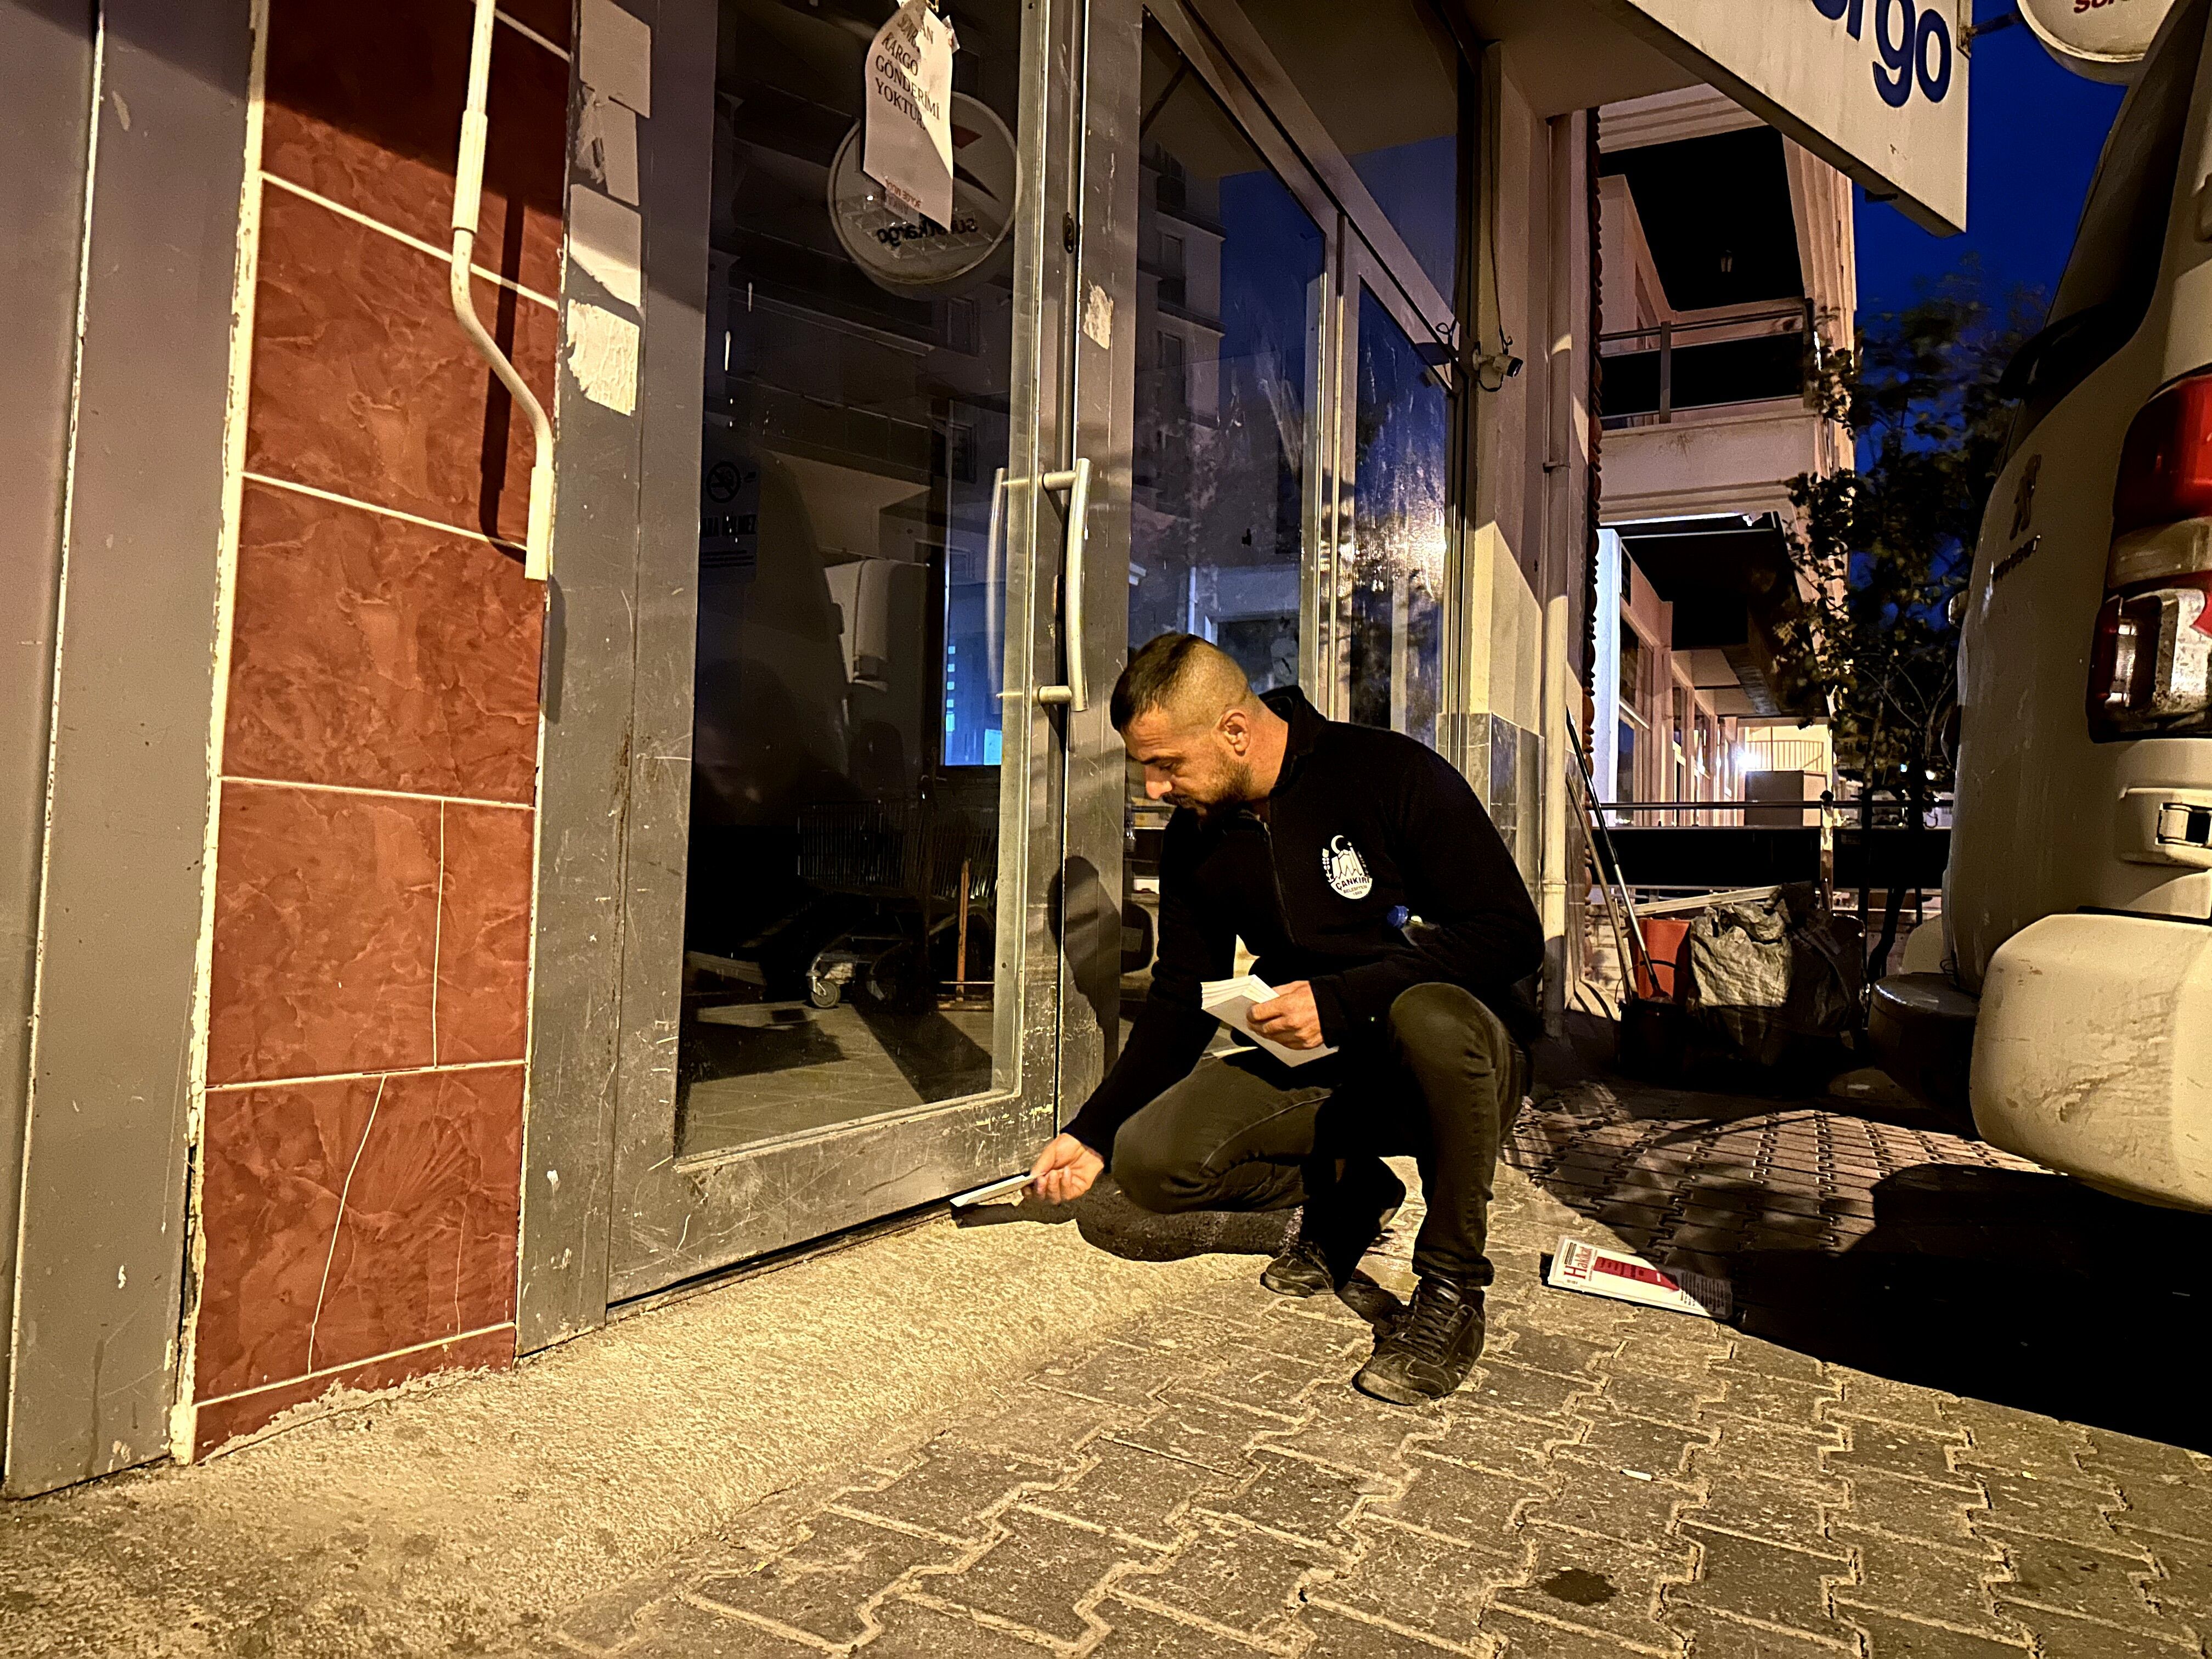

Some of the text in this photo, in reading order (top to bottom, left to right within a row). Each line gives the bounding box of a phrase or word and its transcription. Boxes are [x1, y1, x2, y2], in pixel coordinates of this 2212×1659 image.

[882, 31, 918, 76] KARGO
[874, 77, 926, 131] YOKTUR.
[1335, 877, 1370, 891] ÇANKIRI
